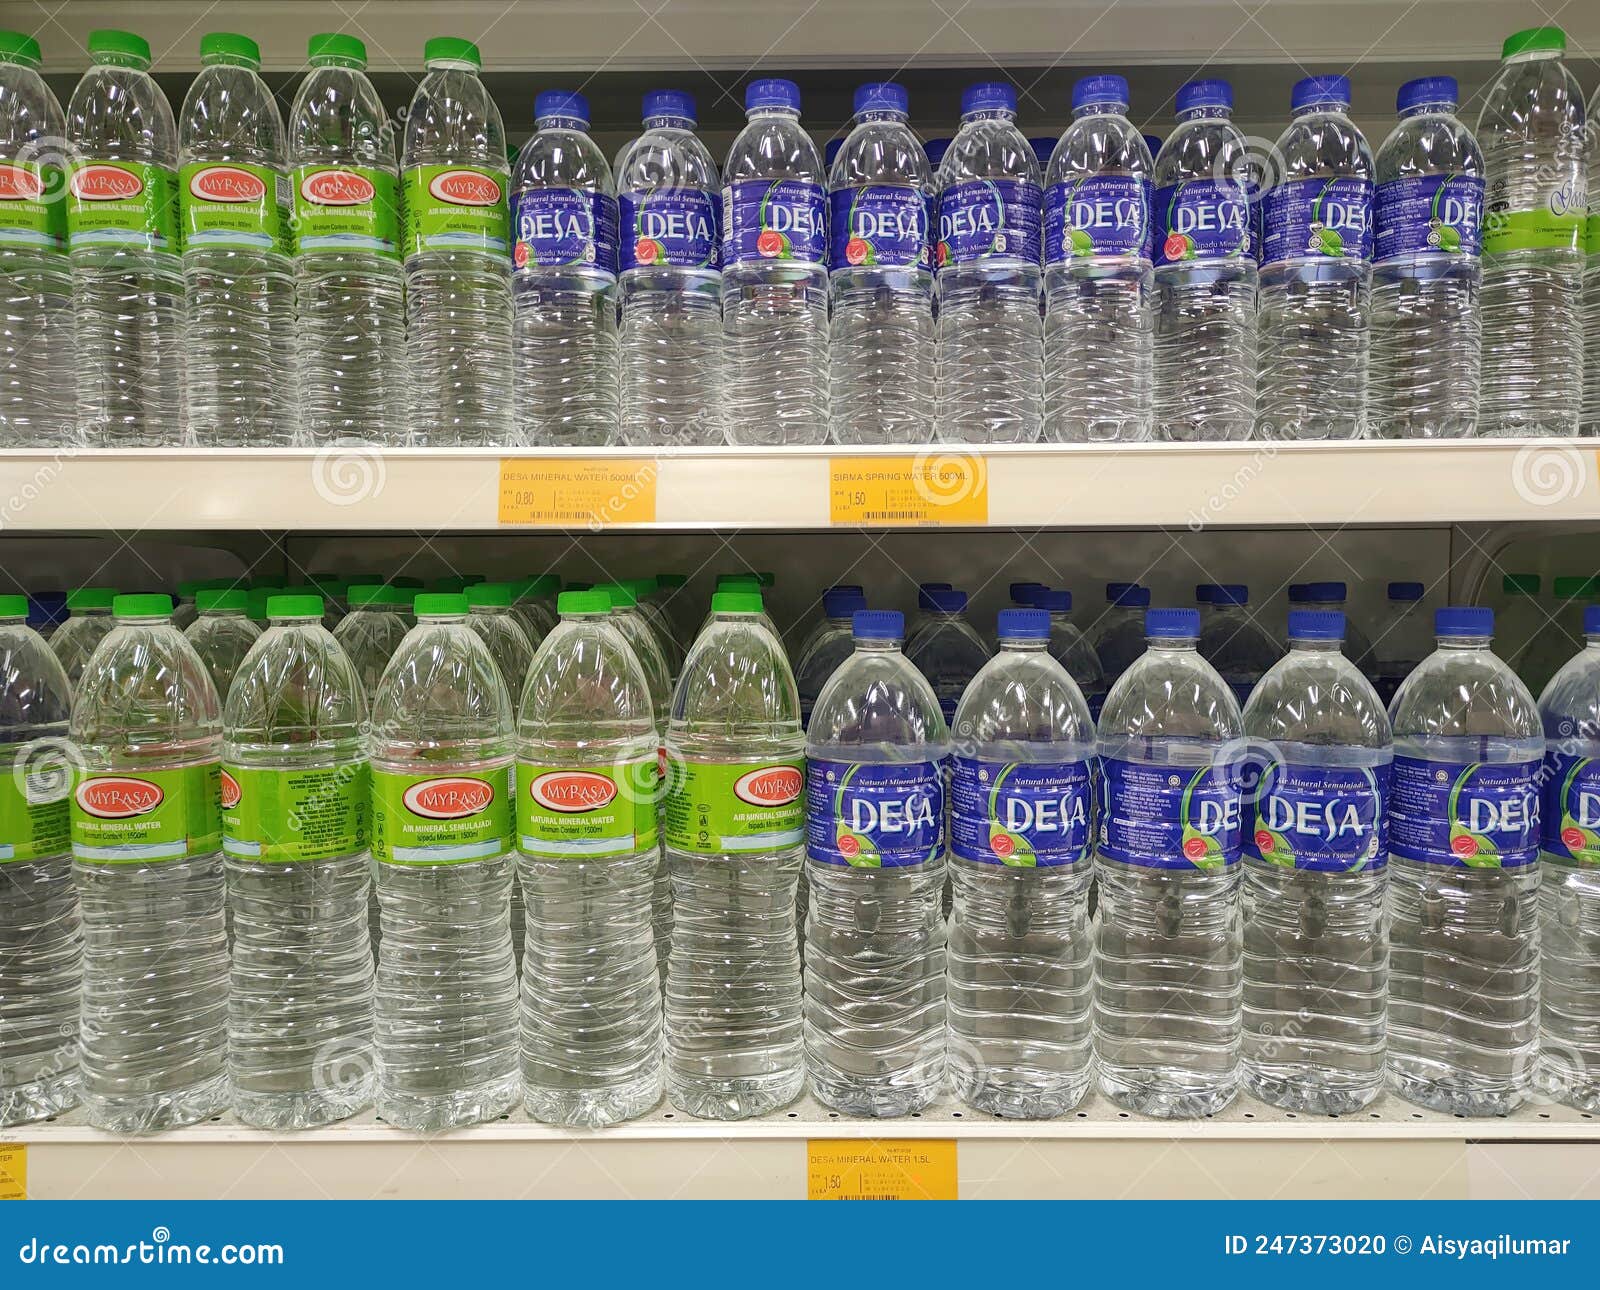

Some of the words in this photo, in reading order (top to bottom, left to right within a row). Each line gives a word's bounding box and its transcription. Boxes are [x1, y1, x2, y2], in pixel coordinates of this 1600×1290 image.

[203, 178, 259, 196] MYRASA
[446, 181, 497, 199] MYRASA
[1101, 182, 1129, 190] Mineral
[772, 204, 825, 238] DESA
[940, 203, 995, 242] DESA
[1075, 198, 1140, 231] DESA
[1177, 200, 1243, 234] DESA
[1326, 201, 1373, 238] DESA
[1444, 198, 1482, 233] DES
[521, 210, 586, 242] DESA
[646, 211, 712, 242] DESA
[858, 210, 922, 242] DESA
[504, 473, 528, 481] DESA
[531, 473, 571, 481] MINERAL
[575, 473, 608, 481] WATER
[833, 473, 863, 481] SIRMA
[866, 473, 900, 481] SPRING
[903, 473, 936, 481] WATER
[515, 490, 534, 505] 0.80
[848, 490, 866, 506] 1.50
[755, 778, 800, 795] MYRASA
[859, 778, 888, 786] Natural
[1015, 777, 1044, 785] Natural
[1290, 779, 1321, 788] Mineral
[1323, 781, 1364, 789] Semulajadi
[1479, 778, 1508, 786] Natural
[89, 789, 153, 807] MYRASA
[423, 789, 486, 807] MYRASA
[546, 784, 609, 801] MYRASA
[531, 815, 557, 825] NATURAL
[559, 817, 589, 825] MINERAL
[591, 816, 614, 824] WATER
[734, 813, 746, 822] AIR
[747, 811, 775, 821] MINERAL
[852, 794, 936, 838] DESA
[1007, 791, 1086, 837] DESA
[1269, 795, 1364, 842] DESA
[1470, 791, 1541, 837] DESA
[403, 824, 414, 832] AIR
[415, 824, 448, 832] MINERAL
[810, 1156, 834, 1164] DESA
[837, 1156, 875, 1164] MINERAL
[878, 1156, 911, 1164] WATER
[913, 1156, 931, 1164] 1.5L
[824, 1175, 841, 1189] 1.50
